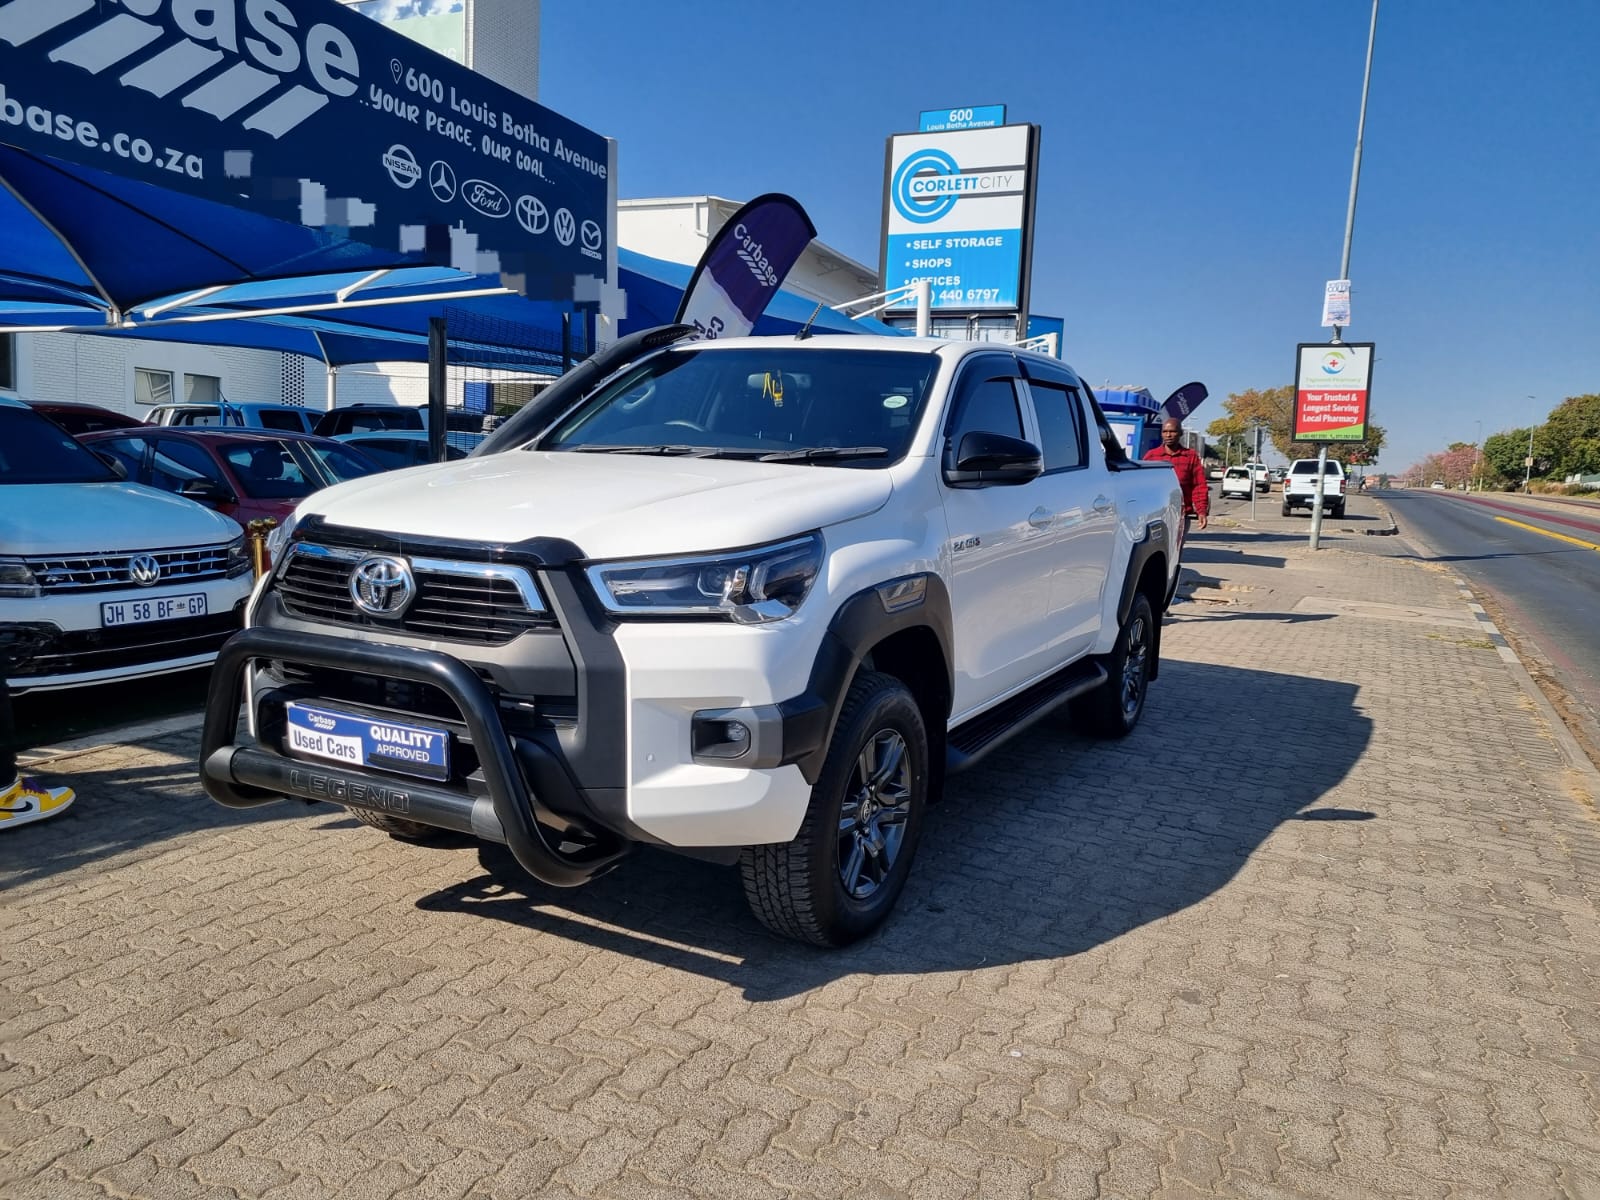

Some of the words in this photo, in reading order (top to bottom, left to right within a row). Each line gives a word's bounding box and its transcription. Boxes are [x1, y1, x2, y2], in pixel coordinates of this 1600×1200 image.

[405, 67, 444, 103] 600
[450, 86, 497, 129] Louis
[502, 111, 550, 153] Botha
[553, 138, 607, 180] Avenue
[949, 109, 973, 122] 600
[968, 119, 995, 127] Avenue
[482, 134, 511, 163] OUR
[384, 157, 420, 175] NISSAN
[471, 184, 503, 211] Ford
[912, 240, 942, 250] SELF
[945, 237, 1004, 248] STORAGE
[734, 224, 778, 286] Carbase
[912, 258, 952, 269] SHOPS
[939, 289, 963, 301] 440
[967, 288, 999, 300] 6797
[1306, 393, 1322, 401] Your
[1324, 393, 1350, 401] Trusted
[1351, 393, 1358, 401] &
[1303, 404, 1331, 413] Longest
[1332, 404, 1360, 413] Serving
[1303, 414, 1321, 422] Local
[1322, 414, 1358, 424] Pharmacy
[106, 605, 125, 623] JH
[133, 602, 150, 620] 58
[157, 600, 174, 618] BF
[188, 597, 204, 614] GP
[308, 712, 337, 726] Carbase
[293, 729, 323, 752] Used
[327, 736, 356, 759] Cars
[370, 725, 433, 749] QUALITY
[376, 743, 430, 762] APPROVED
[290, 769, 410, 813] LEGEND
